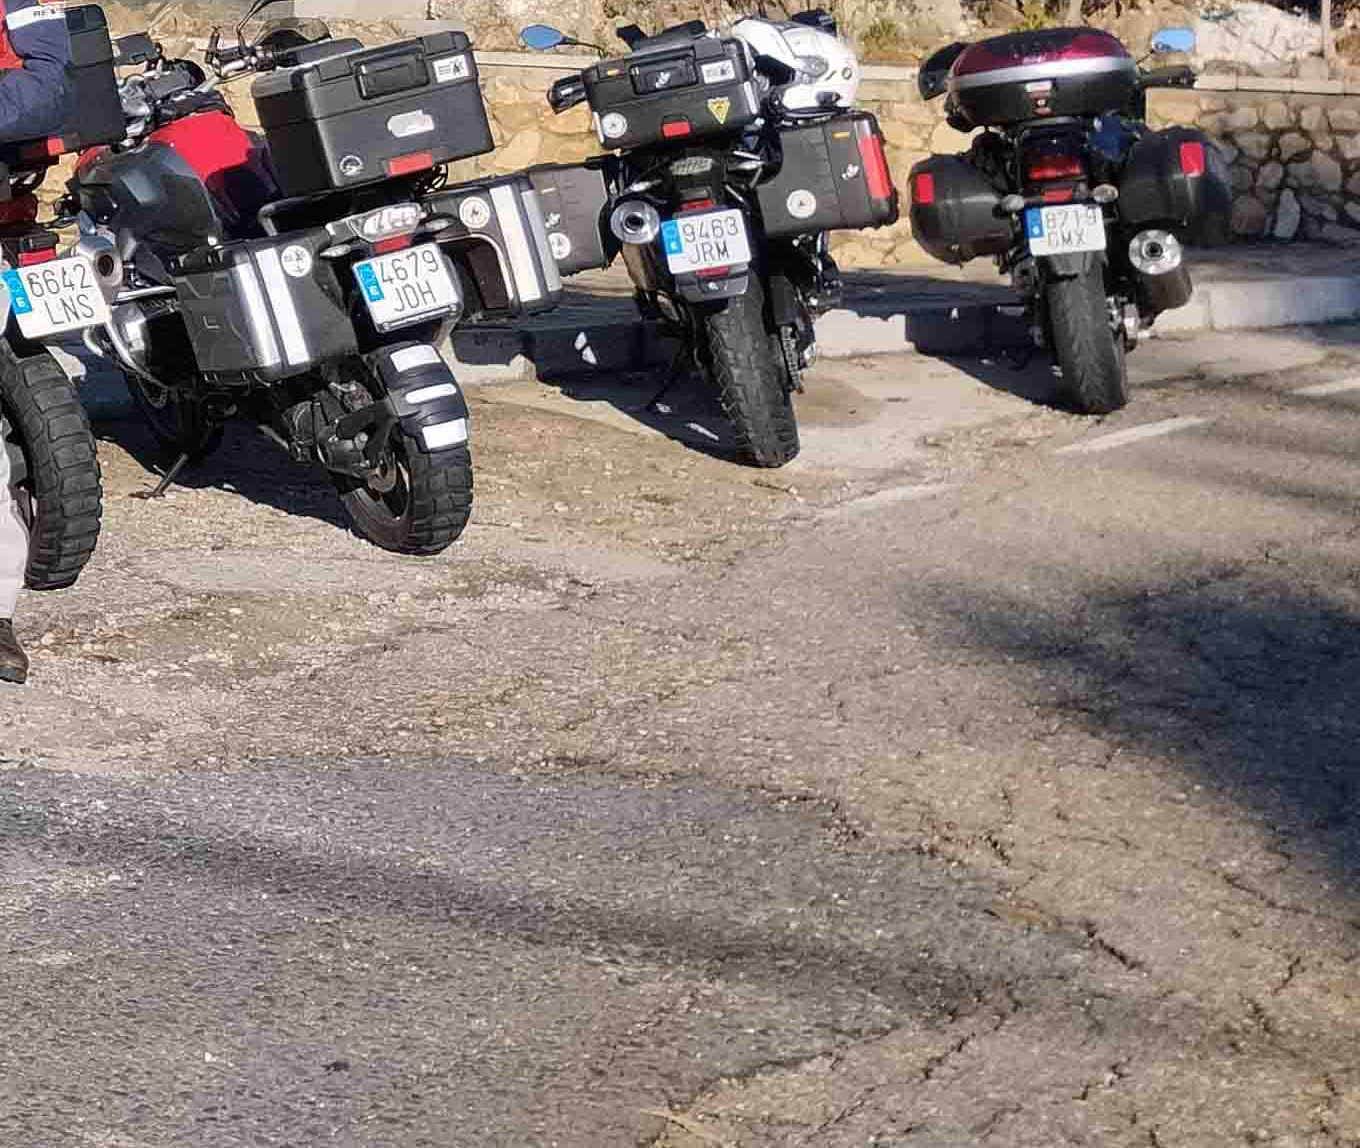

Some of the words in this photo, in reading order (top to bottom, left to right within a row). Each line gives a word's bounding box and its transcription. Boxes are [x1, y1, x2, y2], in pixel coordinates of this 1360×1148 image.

[682, 216, 739, 243] 9463
[380, 250, 439, 283] 4679
[691, 239, 730, 264] JRM
[27, 263, 93, 298] 6642
[43, 293, 94, 324] LNS
